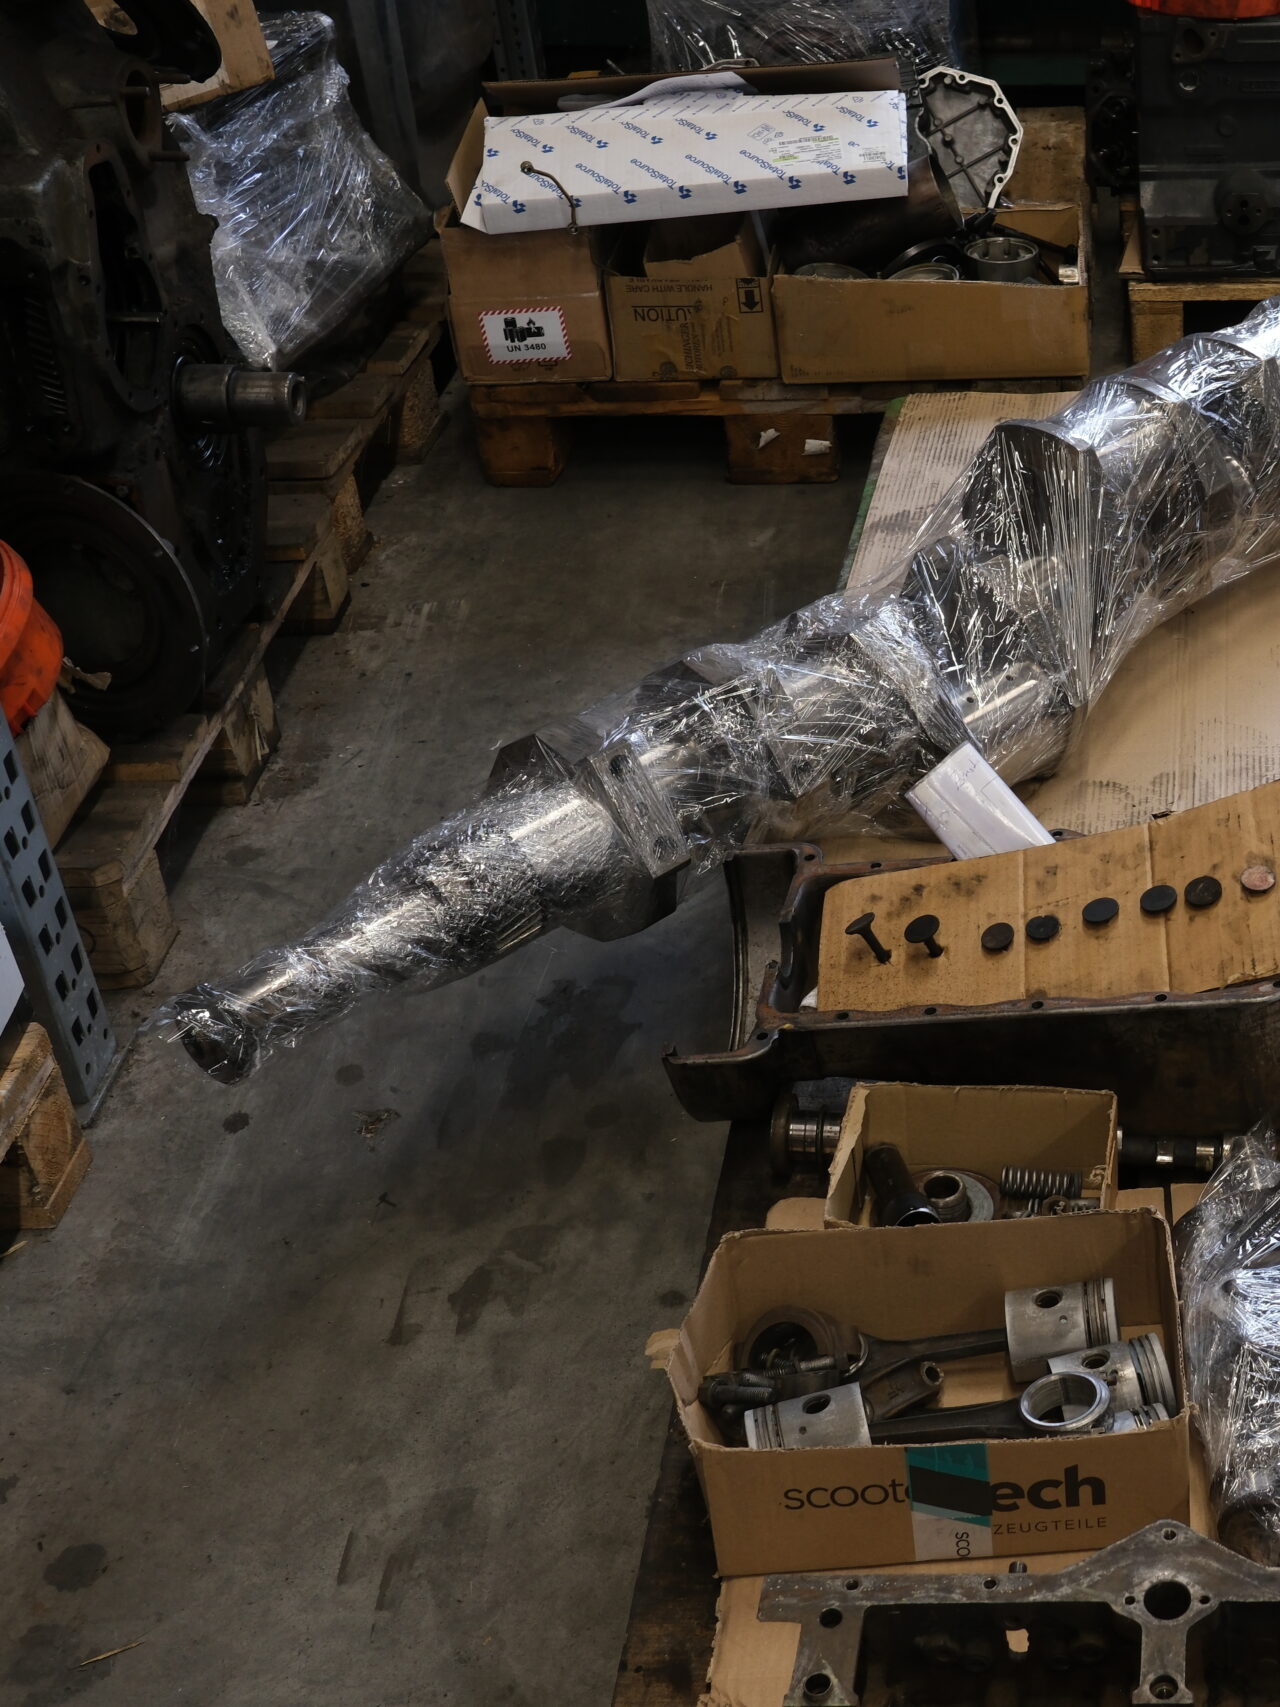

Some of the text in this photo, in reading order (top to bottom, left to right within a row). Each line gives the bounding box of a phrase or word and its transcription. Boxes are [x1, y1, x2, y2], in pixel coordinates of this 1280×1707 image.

[575, 163, 622, 195] TotalSource
[630, 158, 679, 191] TotalSource
[685, 153, 730, 185] TotalSource
[739, 149, 788, 181] TotalSource
[506, 343, 547, 353] UN 3480
[783, 1478, 913, 1510] scoot
